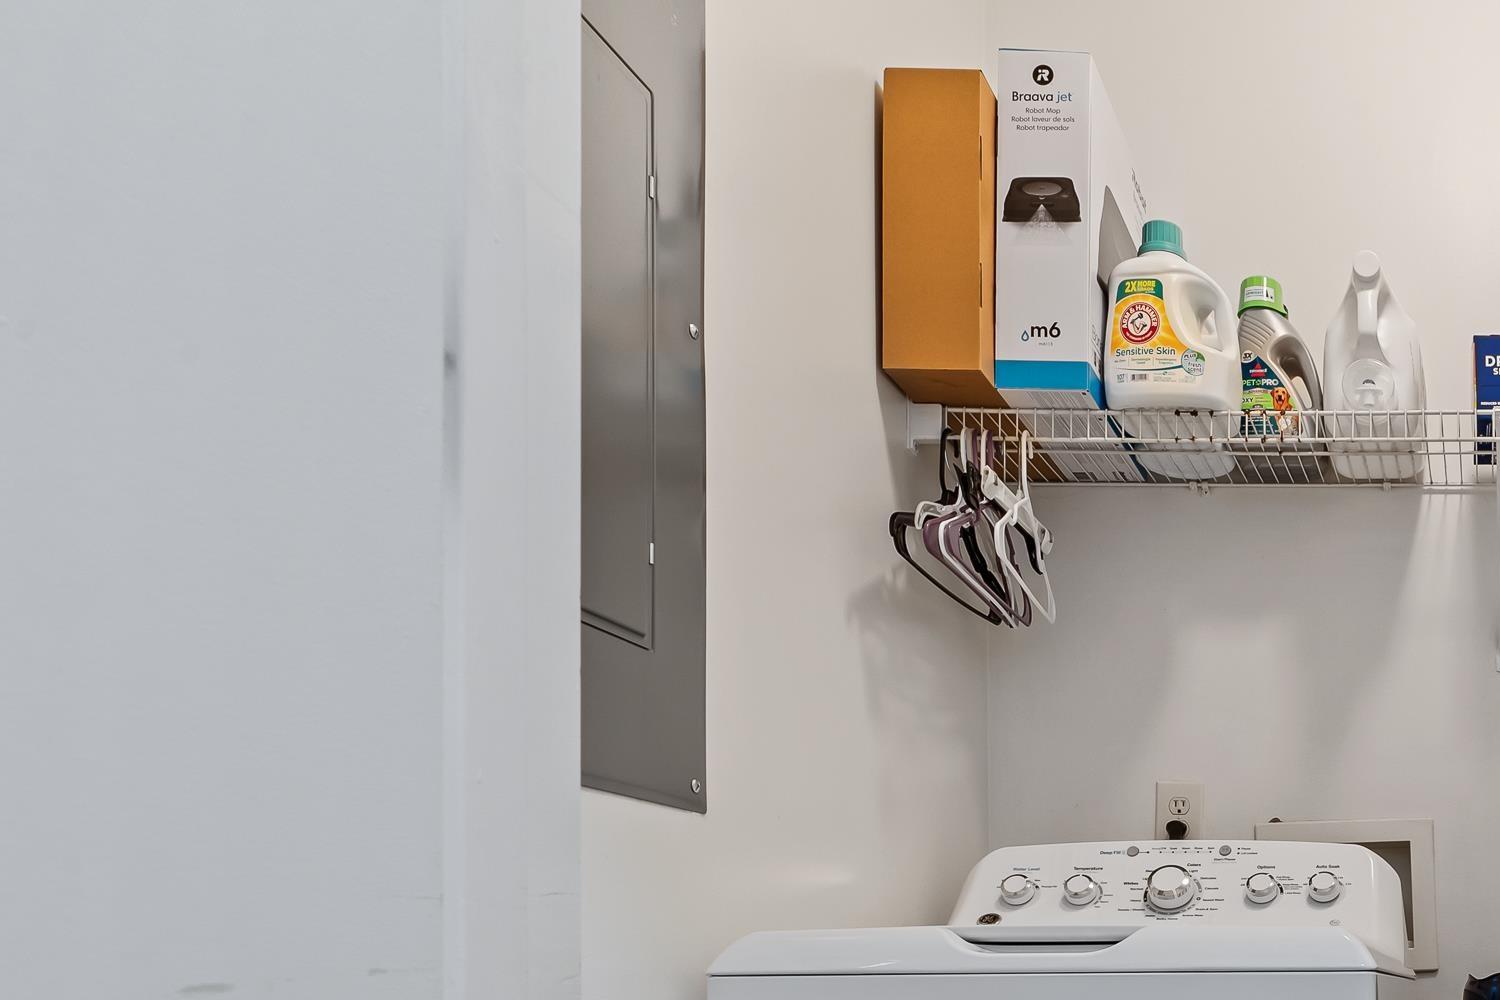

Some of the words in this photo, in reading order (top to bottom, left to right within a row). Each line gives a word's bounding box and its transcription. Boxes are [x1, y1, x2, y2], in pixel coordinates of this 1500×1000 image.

[1012, 90, 1054, 102] Braava
[1055, 90, 1073, 104] jet
[1046, 107, 1061, 115] Mop
[1011, 115, 1031, 123] Robot
[1032, 115, 1051, 123] laveur
[1052, 115, 1062, 123] de
[1063, 115, 1075, 123] sols
[1036, 124, 1070, 132] trapeador
[1124, 280, 1138, 293] 2X
[1135, 304, 1158, 328] HAMMER
[1030, 321, 1062, 339] m6
[1115, 347, 1154, 357] Sensitive
[1156, 346, 1176, 356] Skin
[1261, 378, 1280, 387] PRO
